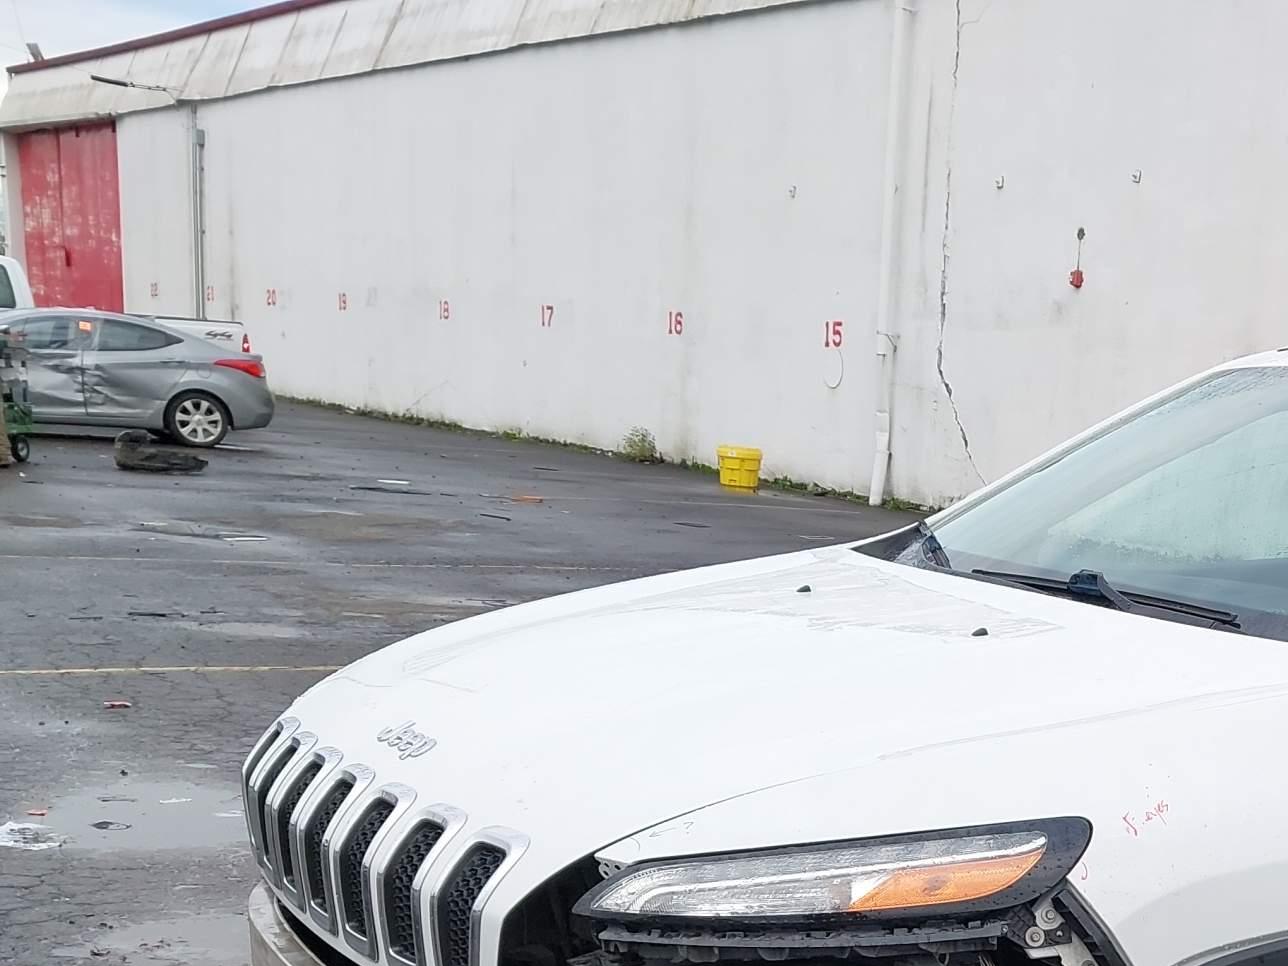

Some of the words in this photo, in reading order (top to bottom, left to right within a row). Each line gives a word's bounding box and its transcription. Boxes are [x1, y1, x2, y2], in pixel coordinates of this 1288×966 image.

[266, 288, 277, 307] 20
[338, 292, 348, 311] 19
[438, 300, 450, 320] 18
[540, 305, 554, 328] 17
[667, 311, 684, 336] 16
[824, 320, 843, 348] 15
[376, 719, 438, 761] Jeep
